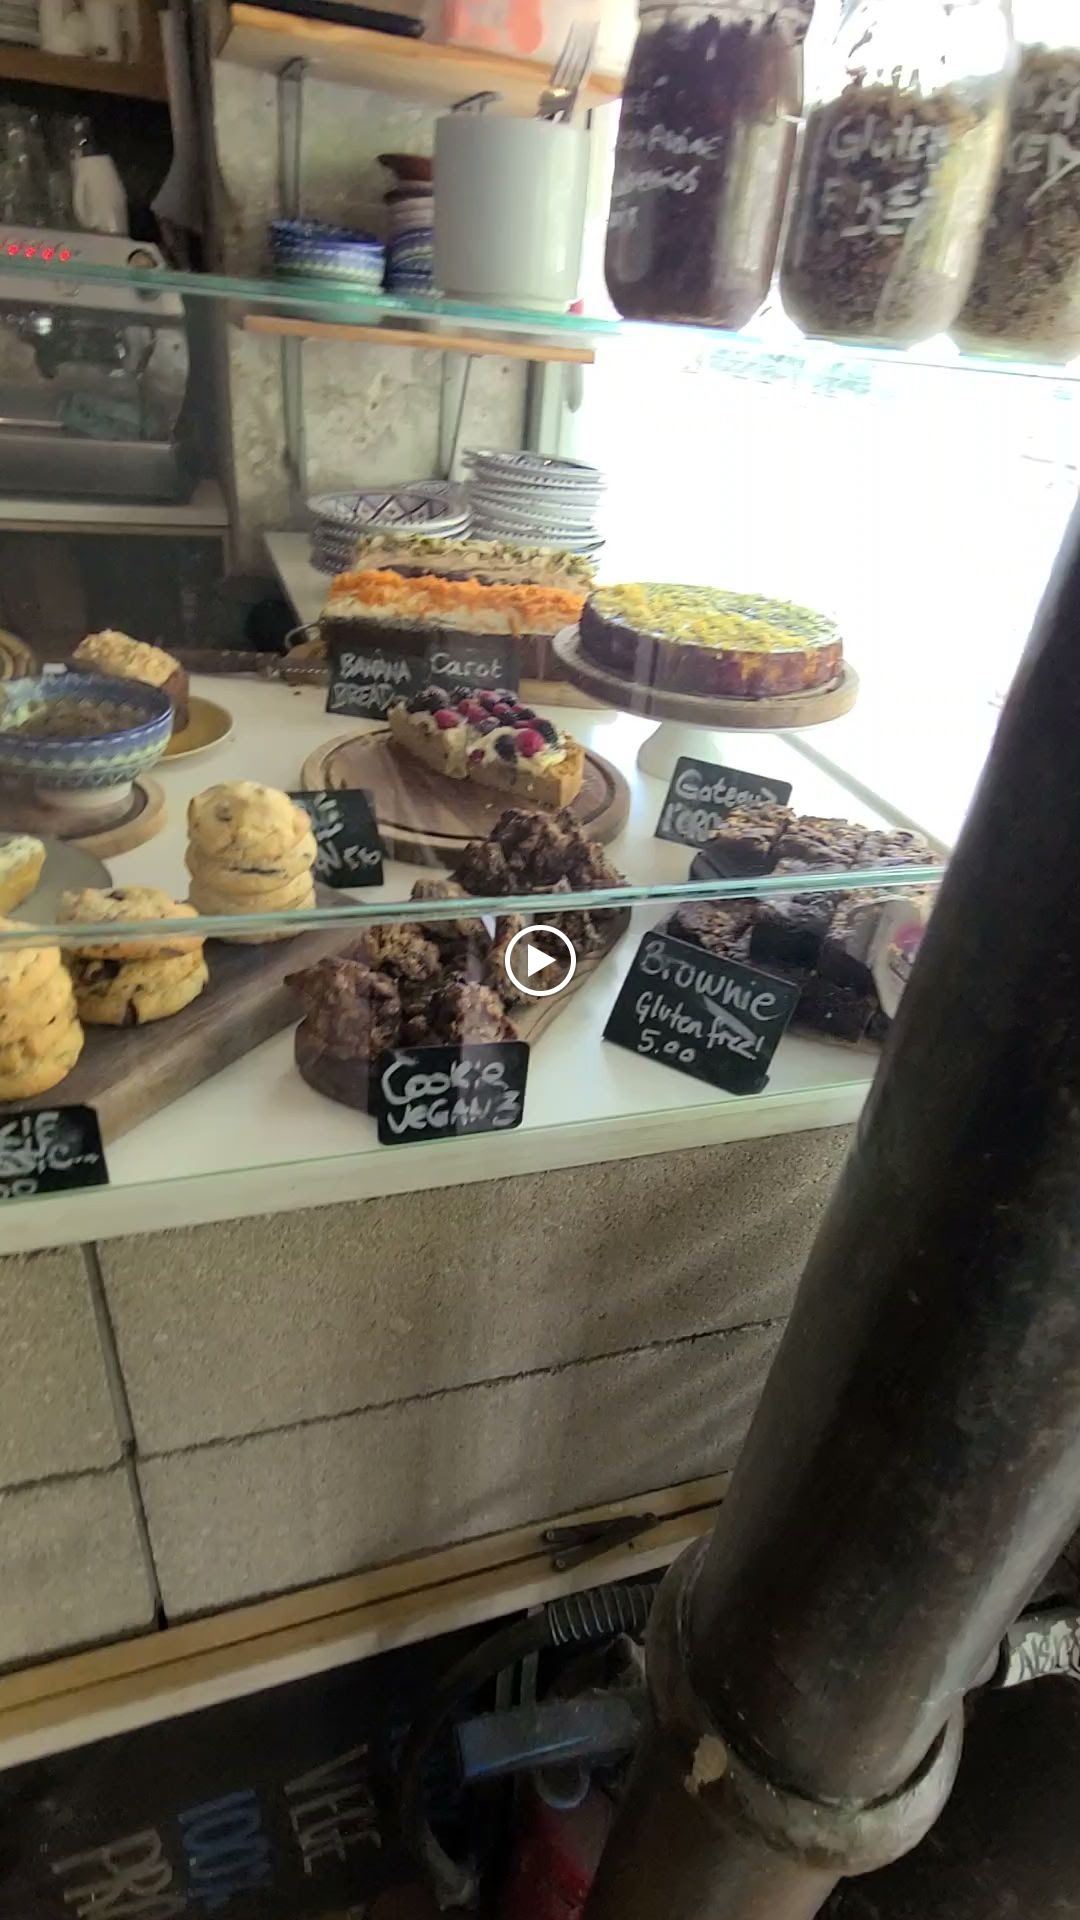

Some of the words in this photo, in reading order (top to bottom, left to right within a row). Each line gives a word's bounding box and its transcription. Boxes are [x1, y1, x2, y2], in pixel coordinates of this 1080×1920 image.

[430, 652, 503, 679] Carot
[635, 991, 703, 1038] Gluten
[637, 1028, 696, 1063] 5.00
